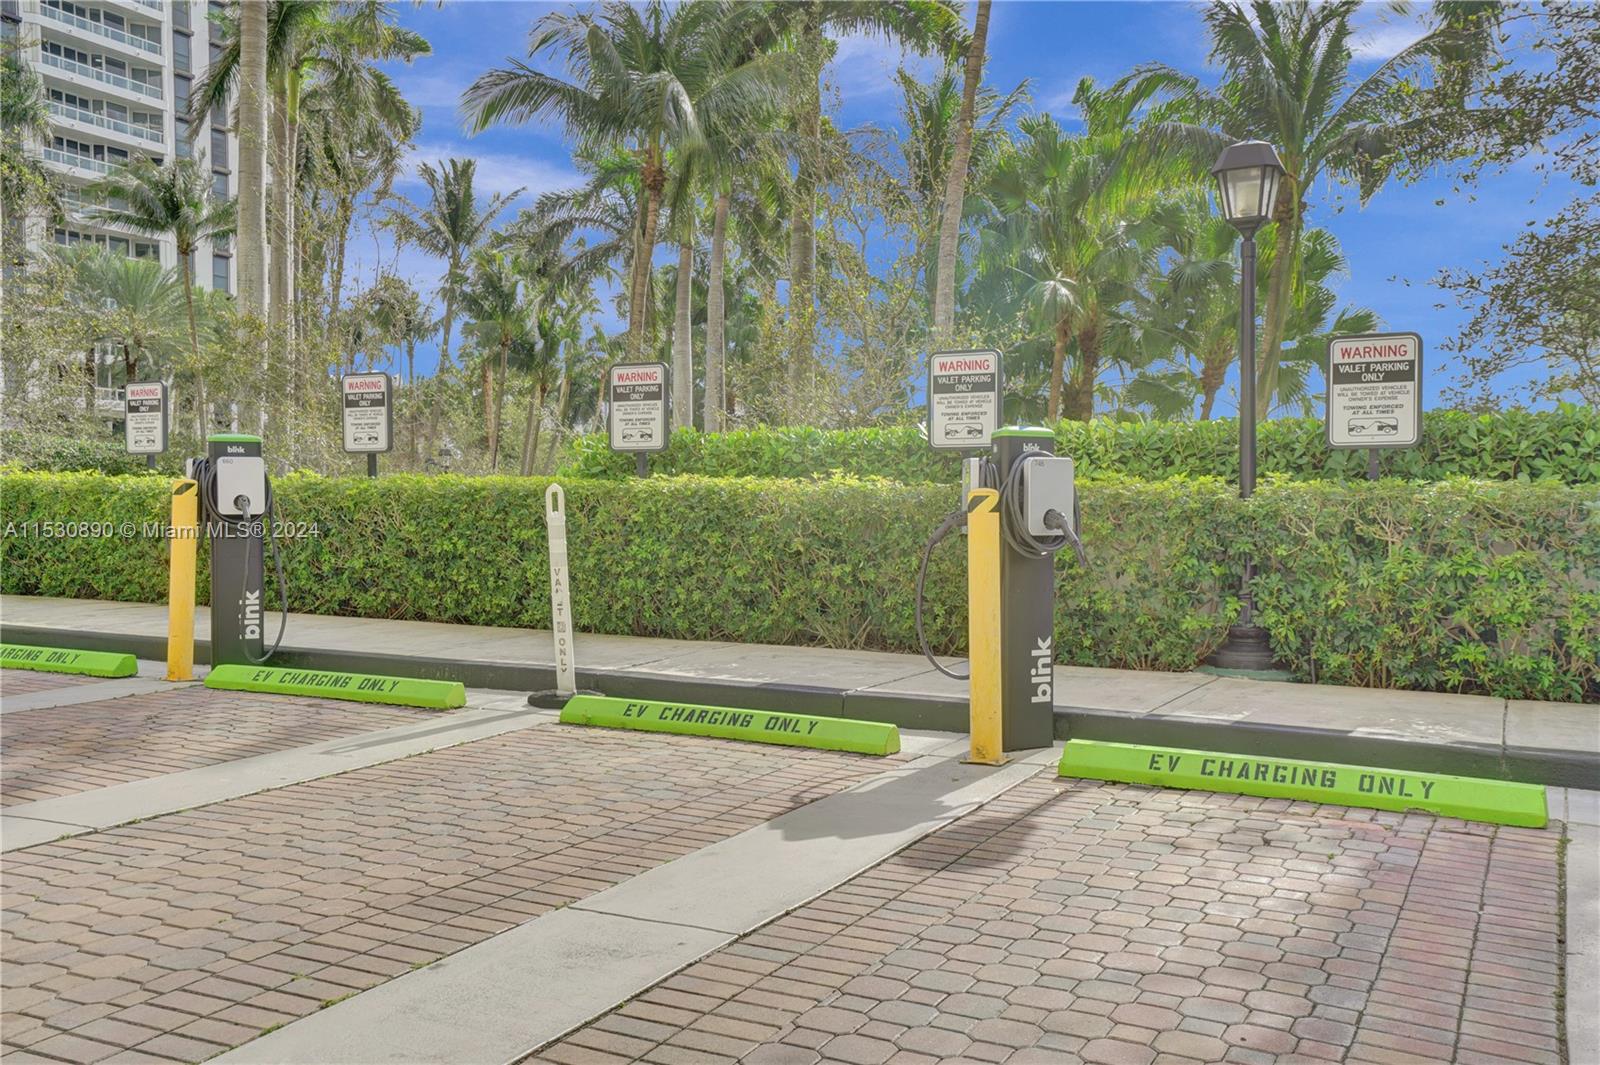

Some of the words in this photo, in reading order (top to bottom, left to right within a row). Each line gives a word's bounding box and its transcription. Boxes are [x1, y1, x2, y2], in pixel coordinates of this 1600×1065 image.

[1340, 345, 1407, 359] WARNING
[939, 360, 989, 372] WARNING
[1339, 364, 1366, 373] VALET
[1370, 362, 1409, 372] PARKING
[617, 371, 657, 382] WARNING
[937, 376, 958, 384] VALET
[961, 375, 991, 383] PARKING
[1362, 373, 1384, 381] ONLY
[348, 381, 381, 391] WARNING
[130, 388, 158, 397] WARNING
[227, 446, 246, 454] blink
[1023, 442, 1040, 451] blink
[45, 652, 81, 664] ONLY
[1030, 635, 1052, 703] blink
[252, 670, 274, 682] EV
[279, 672, 352, 688] CHARGING
[357, 678, 400, 693] ONLY
[623, 703, 649, 718] EV
[659, 706, 754, 728] CHARGING
[764, 716, 819, 735] ONLY
[1149, 753, 1181, 773] EV
[1200, 758, 1337, 788] CHARGING
[1358, 773, 1436, 800] ONLY
